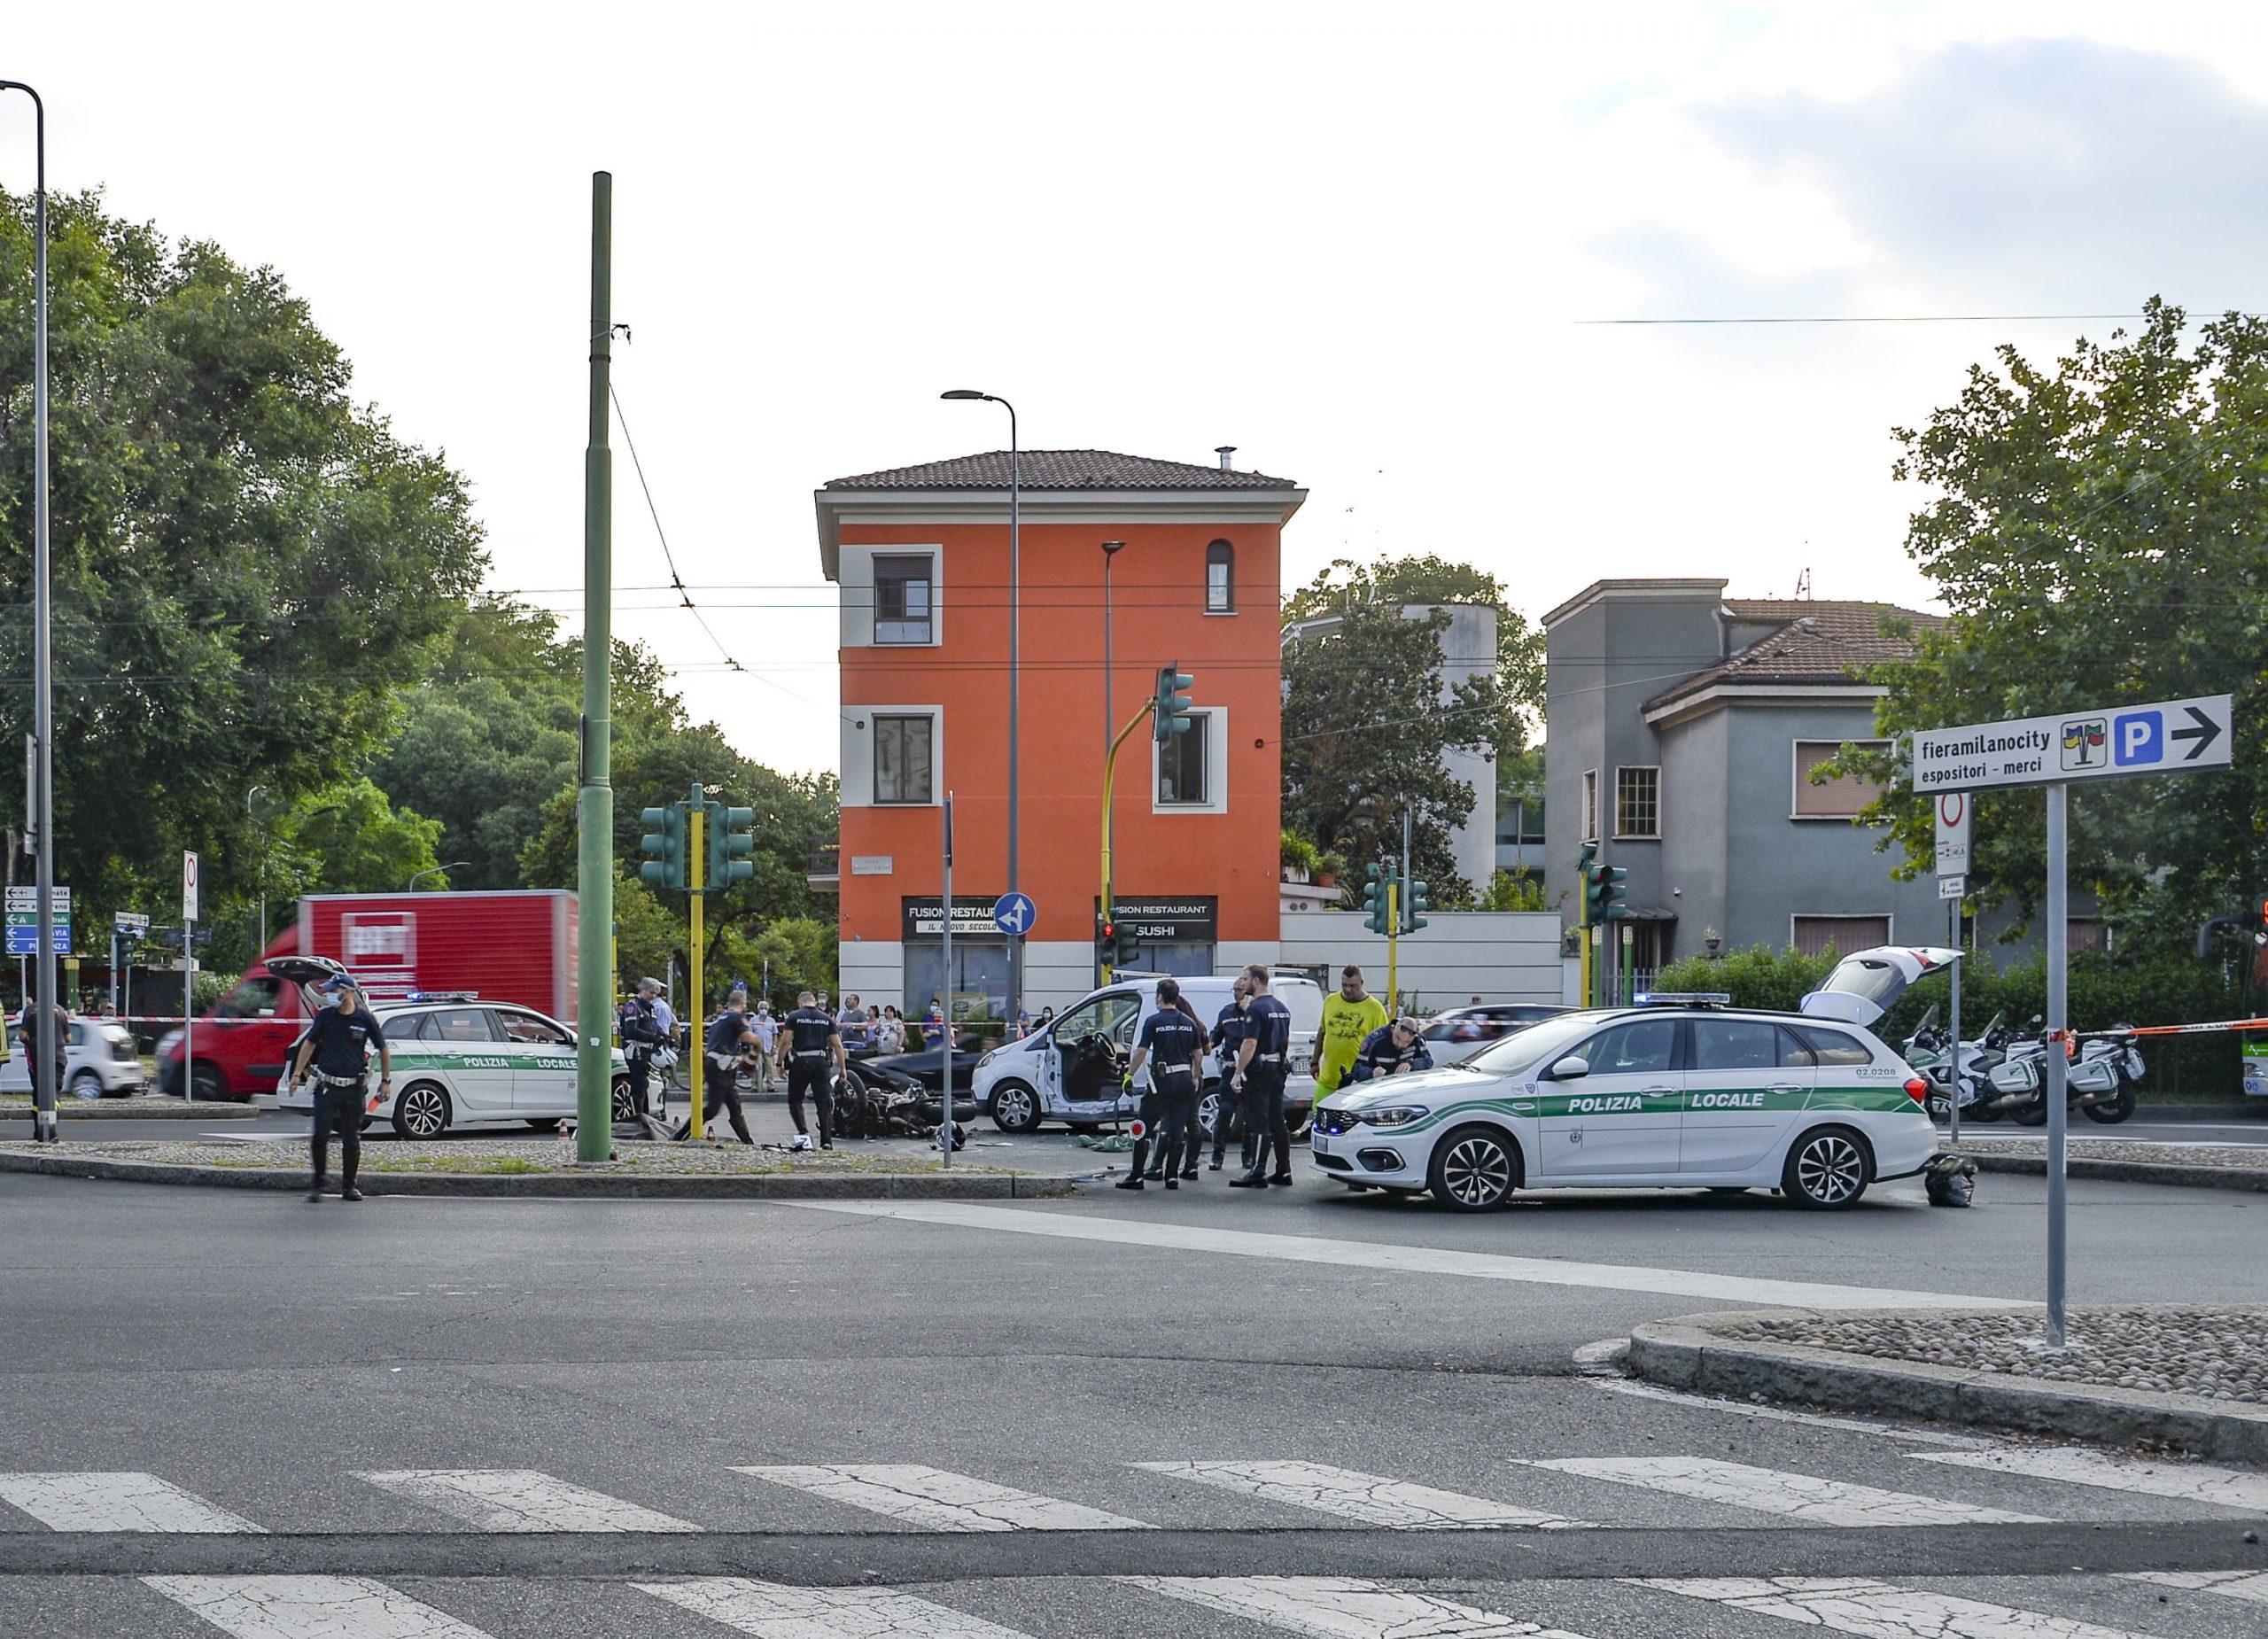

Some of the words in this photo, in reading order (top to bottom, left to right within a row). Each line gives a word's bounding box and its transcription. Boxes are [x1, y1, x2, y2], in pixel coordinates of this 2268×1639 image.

[1922, 730, 2051, 759] fieramilanocity
[2124, 720, 2152, 758] P
[1922, 766, 1987, 783] espositori
[2003, 757, 2042, 776] merci
[1143, 905, 1208, 914] RESTAURANT
[1136, 926, 1176, 936] SUSHI
[462, 1056, 509, 1068] POLIZIA
[536, 1058, 579, 1069] LOCALE
[1567, 1096, 1643, 1114] POLIZIA
[1690, 1092, 1765, 1108] LOCALE
